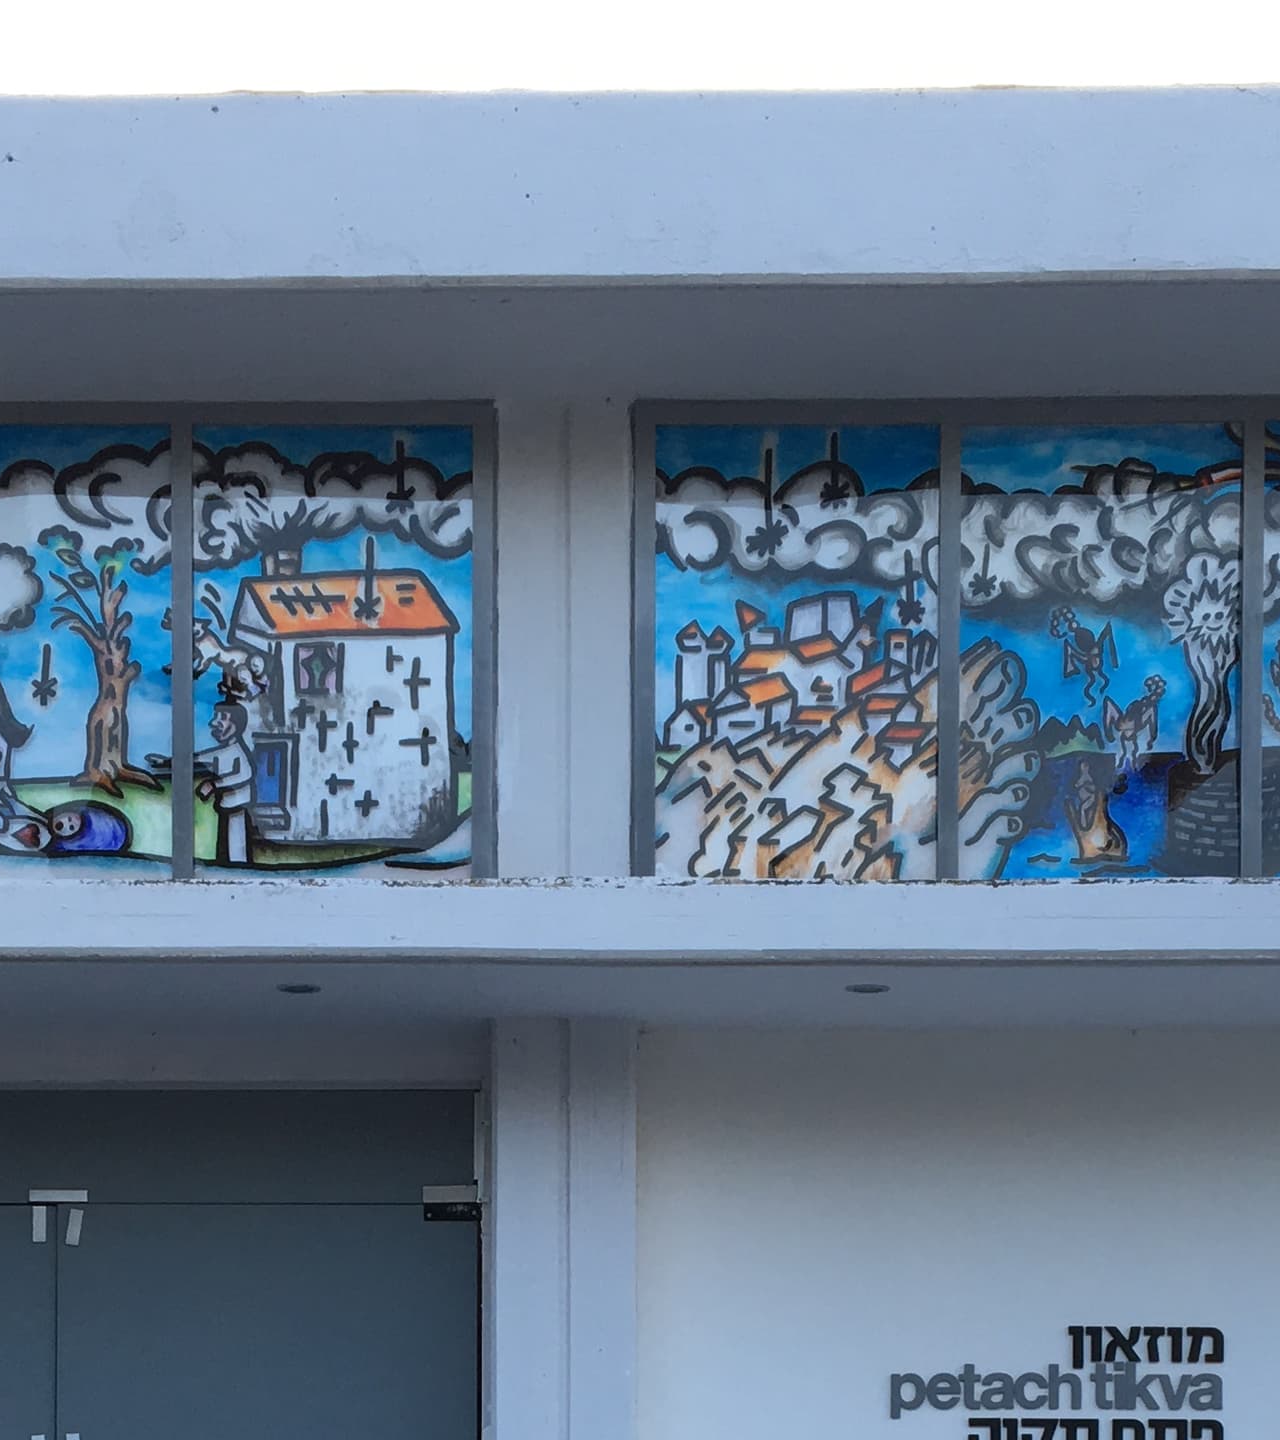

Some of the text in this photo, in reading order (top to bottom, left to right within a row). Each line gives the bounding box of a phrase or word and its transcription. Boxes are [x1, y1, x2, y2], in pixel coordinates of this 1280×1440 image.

[1068, 1326, 1224, 1369] מוזאון
[890, 1362, 1223, 1419] petach tikva
